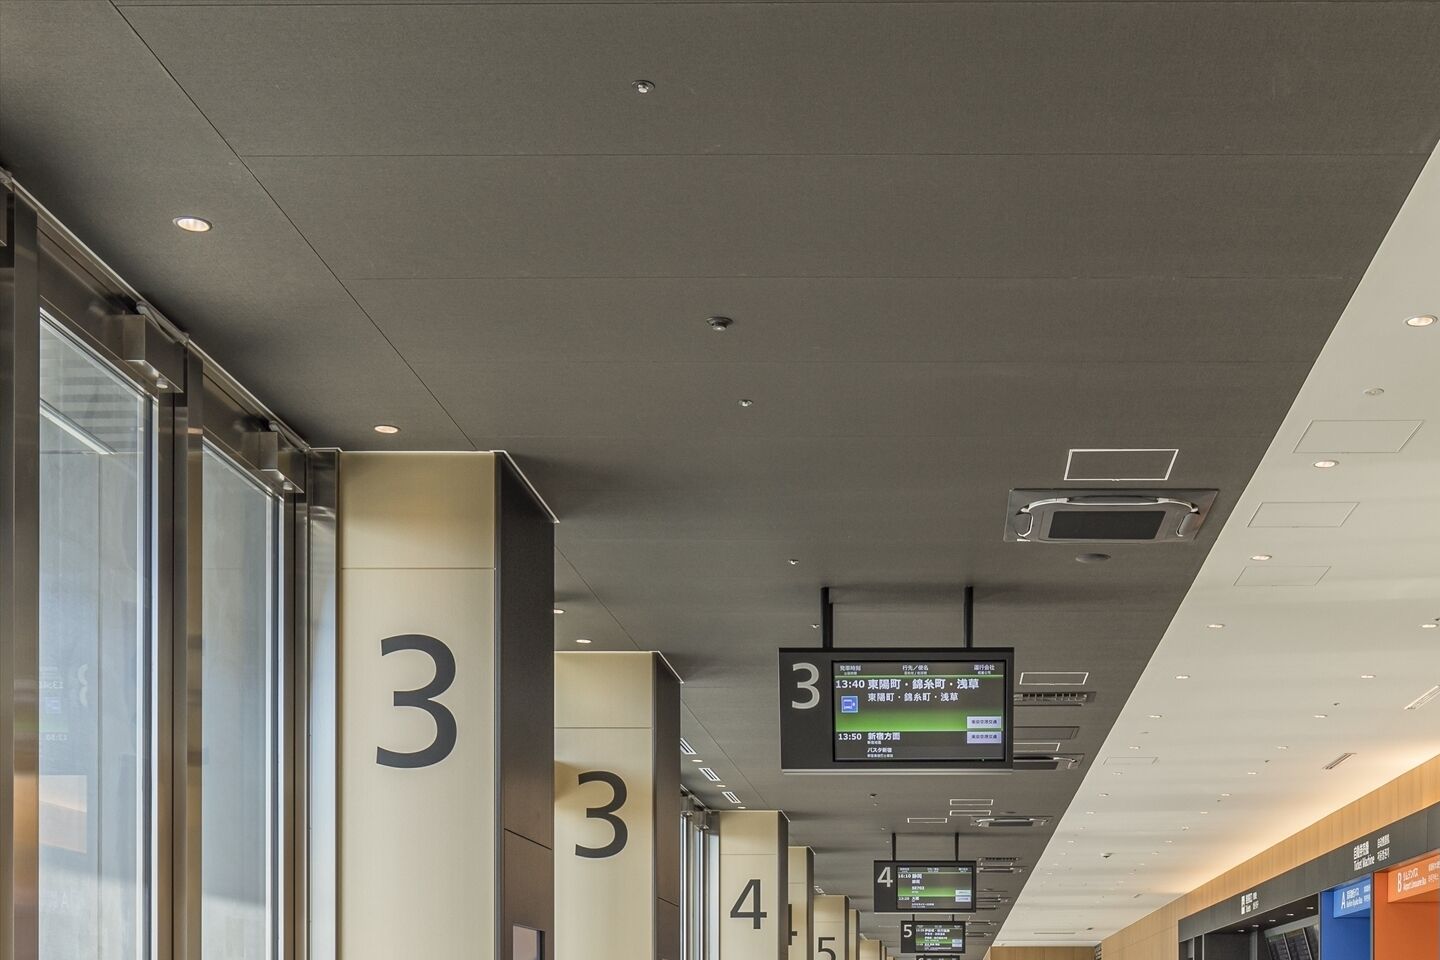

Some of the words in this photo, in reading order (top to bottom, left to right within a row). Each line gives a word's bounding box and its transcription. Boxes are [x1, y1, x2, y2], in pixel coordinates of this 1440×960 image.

[791, 662, 820, 710] 3
[835, 680, 865, 689] 13:40
[376, 634, 457, 769] 3
[838, 733, 862, 741] 13:50
[575, 770, 628, 859] 3
[877, 866, 893, 888] 4
[1397, 872, 1402, 892] B
[729, 878, 767, 930] 4
[1341, 891, 1346, 909] A
[903, 924, 913, 938] 5
